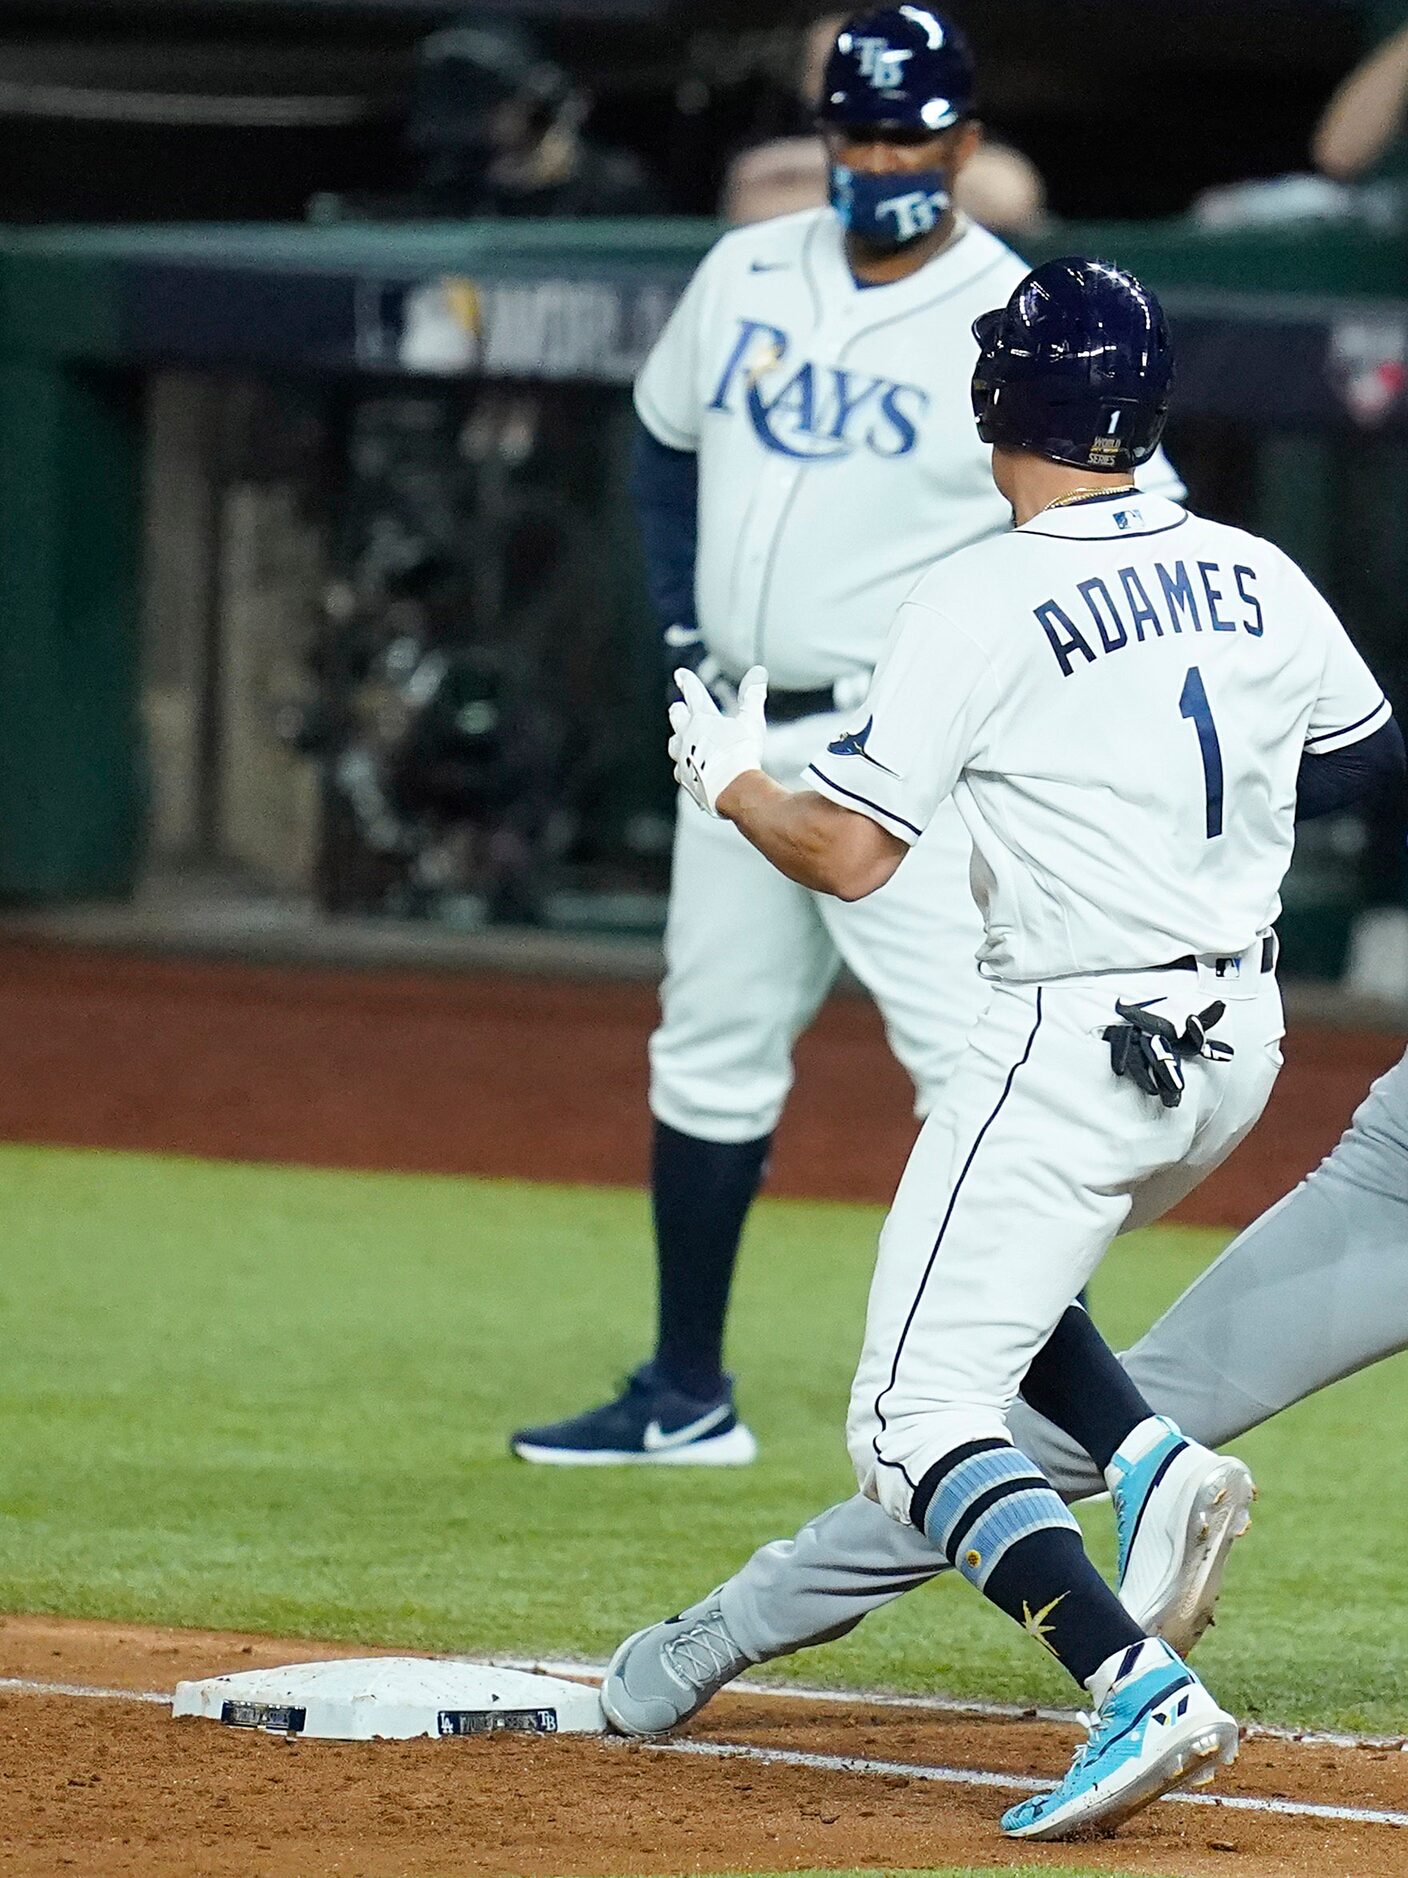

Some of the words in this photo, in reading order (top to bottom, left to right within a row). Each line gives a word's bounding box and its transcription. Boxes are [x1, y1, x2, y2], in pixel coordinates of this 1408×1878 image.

[854, 36, 904, 88] TB
[705, 319, 931, 461] RAYS
[1107, 410, 1121, 434] 1
[1087, 452, 1117, 466] SERIES
[1092, 436, 1121, 447] WORLD
[1032, 560, 1264, 677] ADAMES
[1178, 666, 1224, 839] 1
[440, 1712, 454, 1734] LA
[537, 1710, 556, 1731] TB
